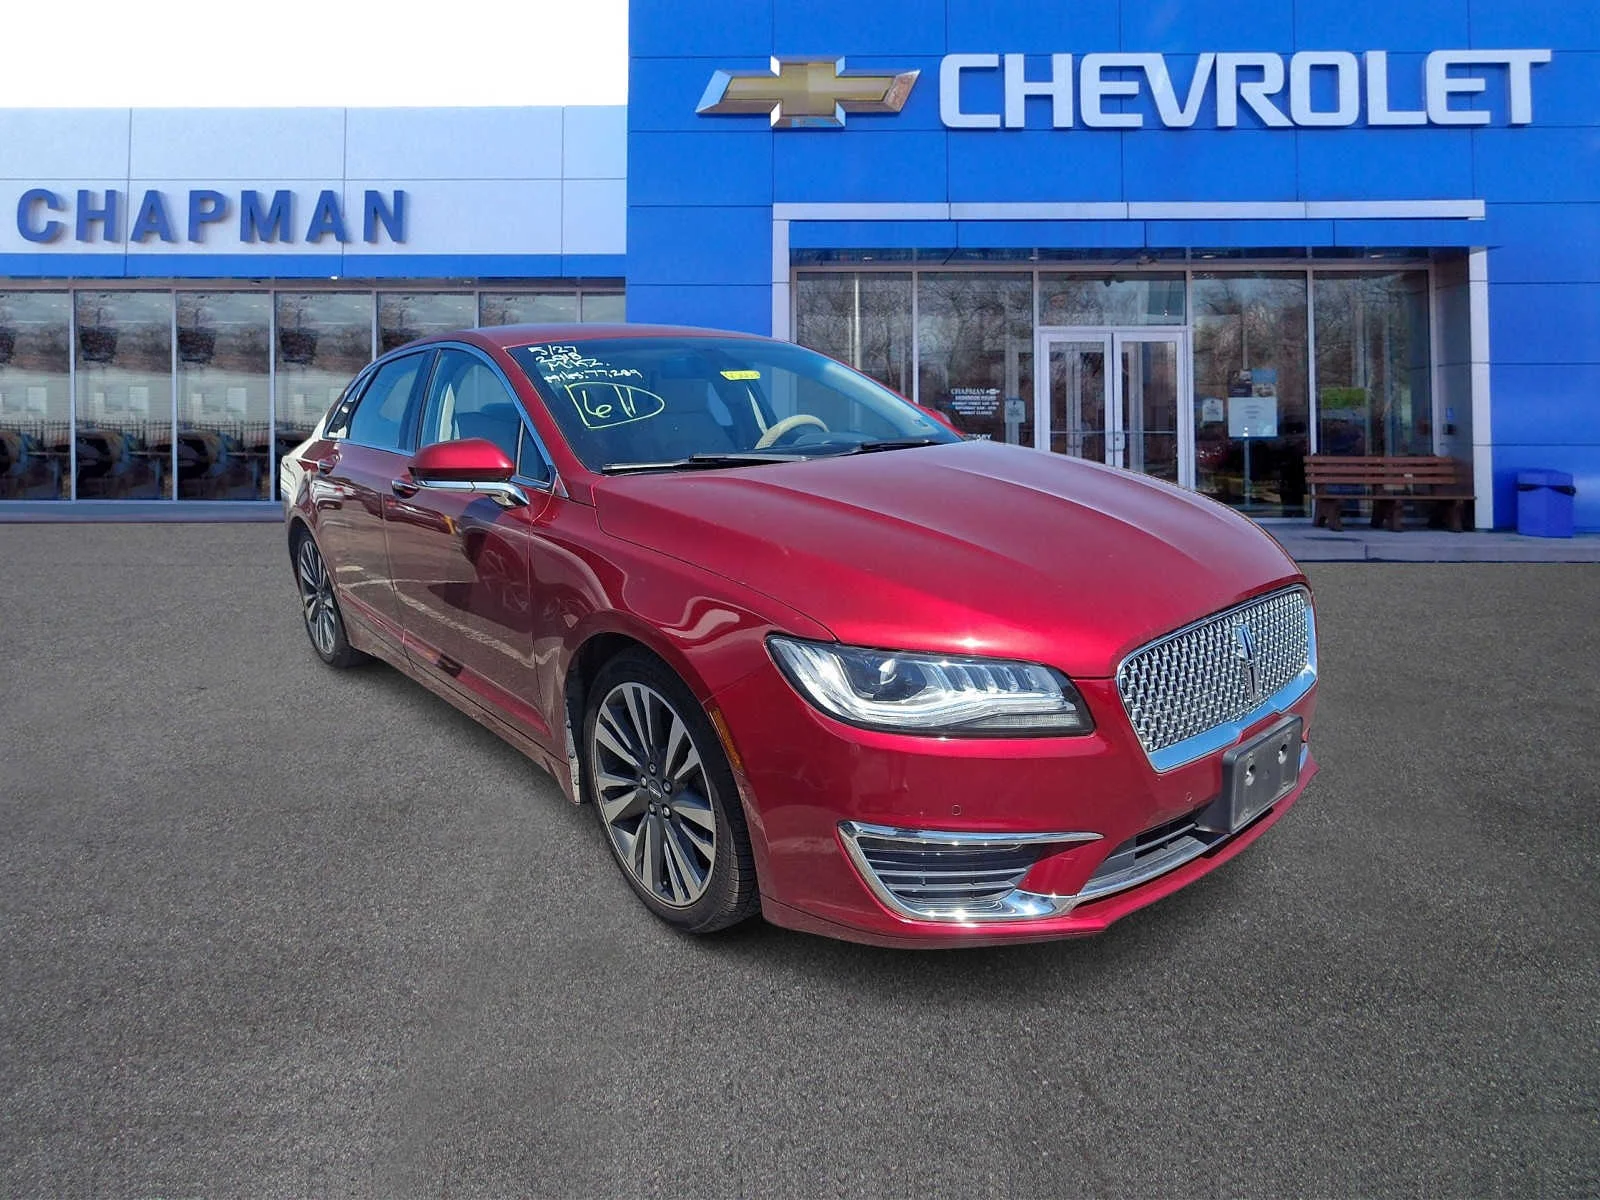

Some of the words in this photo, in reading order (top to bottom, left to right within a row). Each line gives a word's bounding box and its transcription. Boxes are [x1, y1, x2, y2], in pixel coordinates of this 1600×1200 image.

[939, 49, 1552, 129] CHEVROLET
[16, 188, 407, 243] CHAPMAN
[528, 345, 577, 356] 5/27
